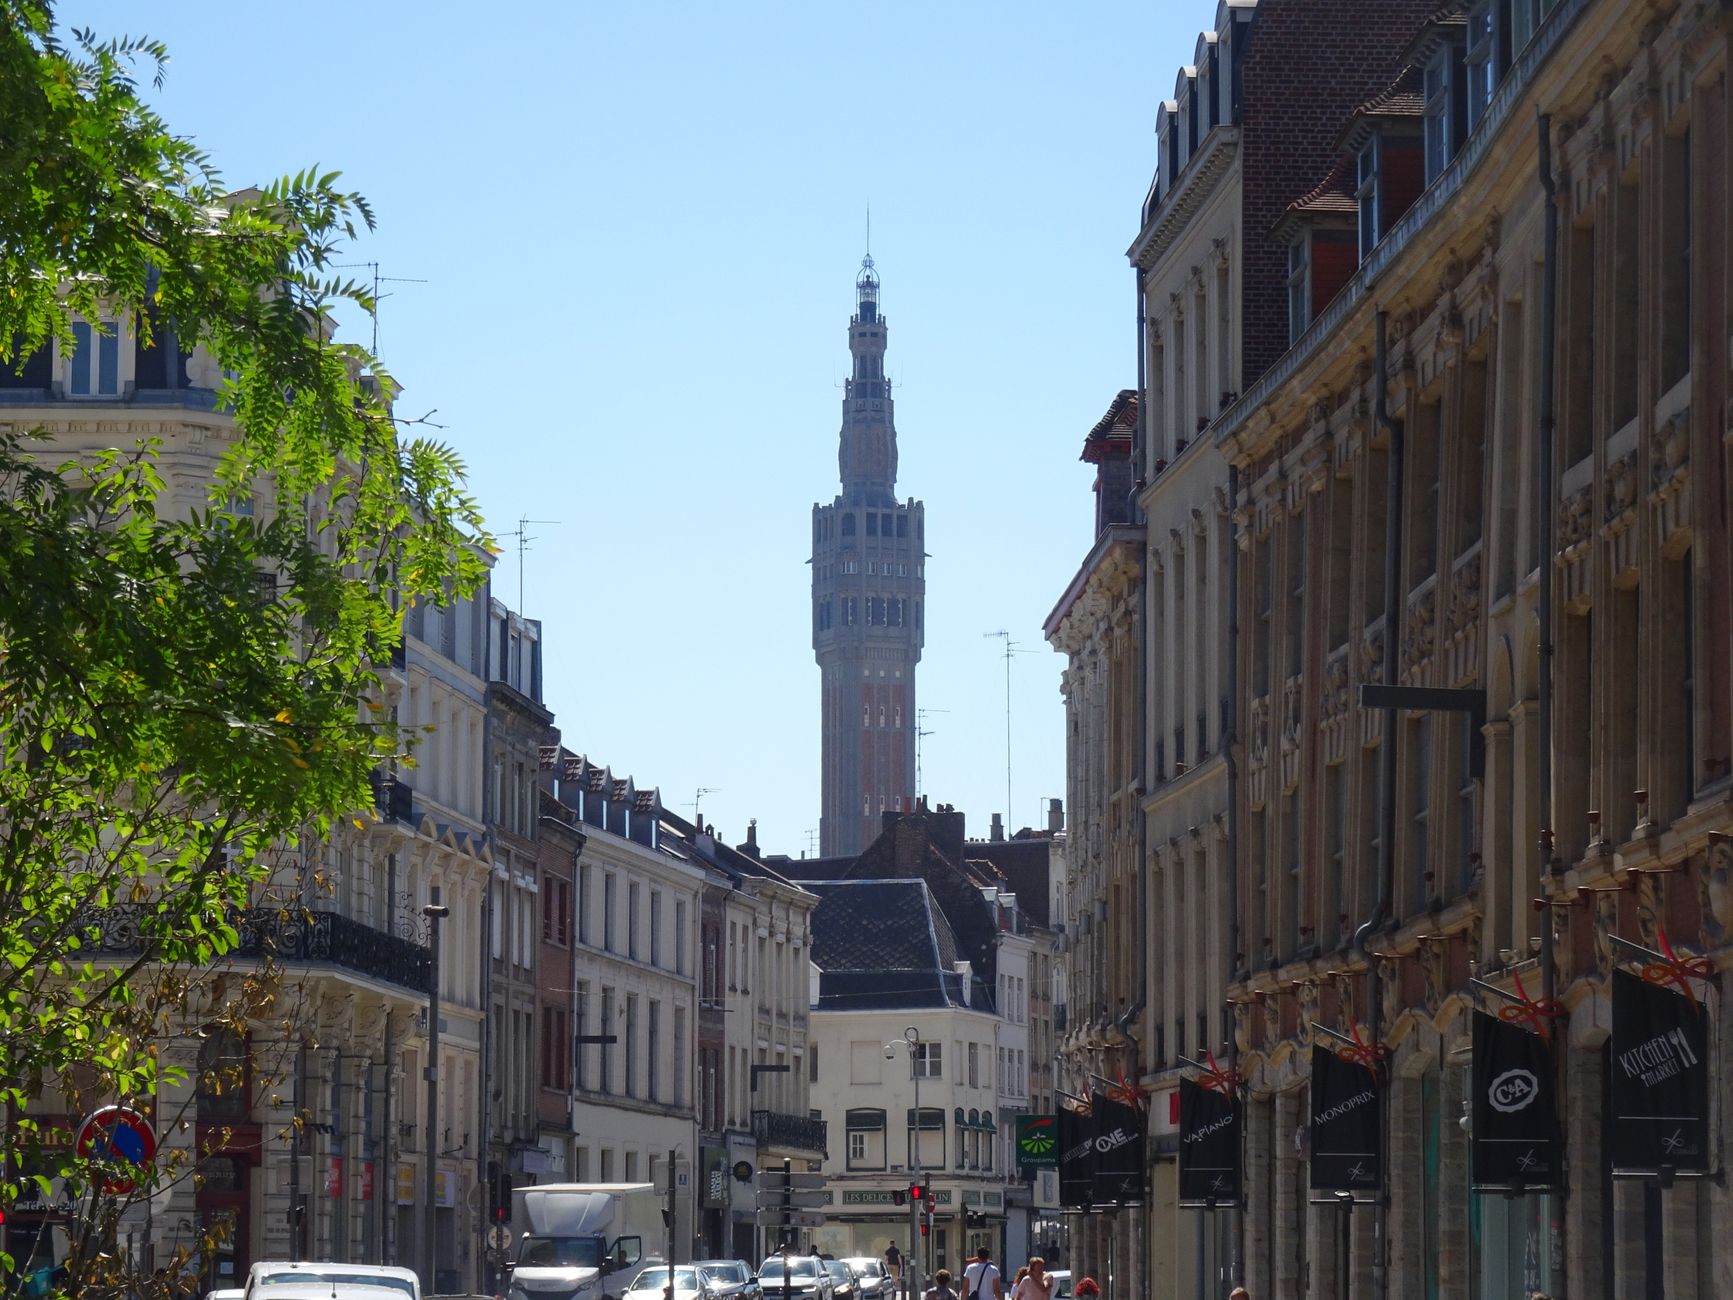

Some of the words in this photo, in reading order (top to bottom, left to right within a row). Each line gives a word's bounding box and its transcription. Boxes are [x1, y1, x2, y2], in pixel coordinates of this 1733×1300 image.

[1619, 1035, 1674, 1079] KITCHEN
[1496, 1078, 1532, 1103] C&A
[1314, 1089, 1376, 1125] MONOPRIX
[1183, 1115, 1233, 1143] VAPIANO
[1021, 1156, 1056, 1164] Groupama
[846, 1193, 860, 1202] LES
[862, 1193, 894, 1202] DELICE
